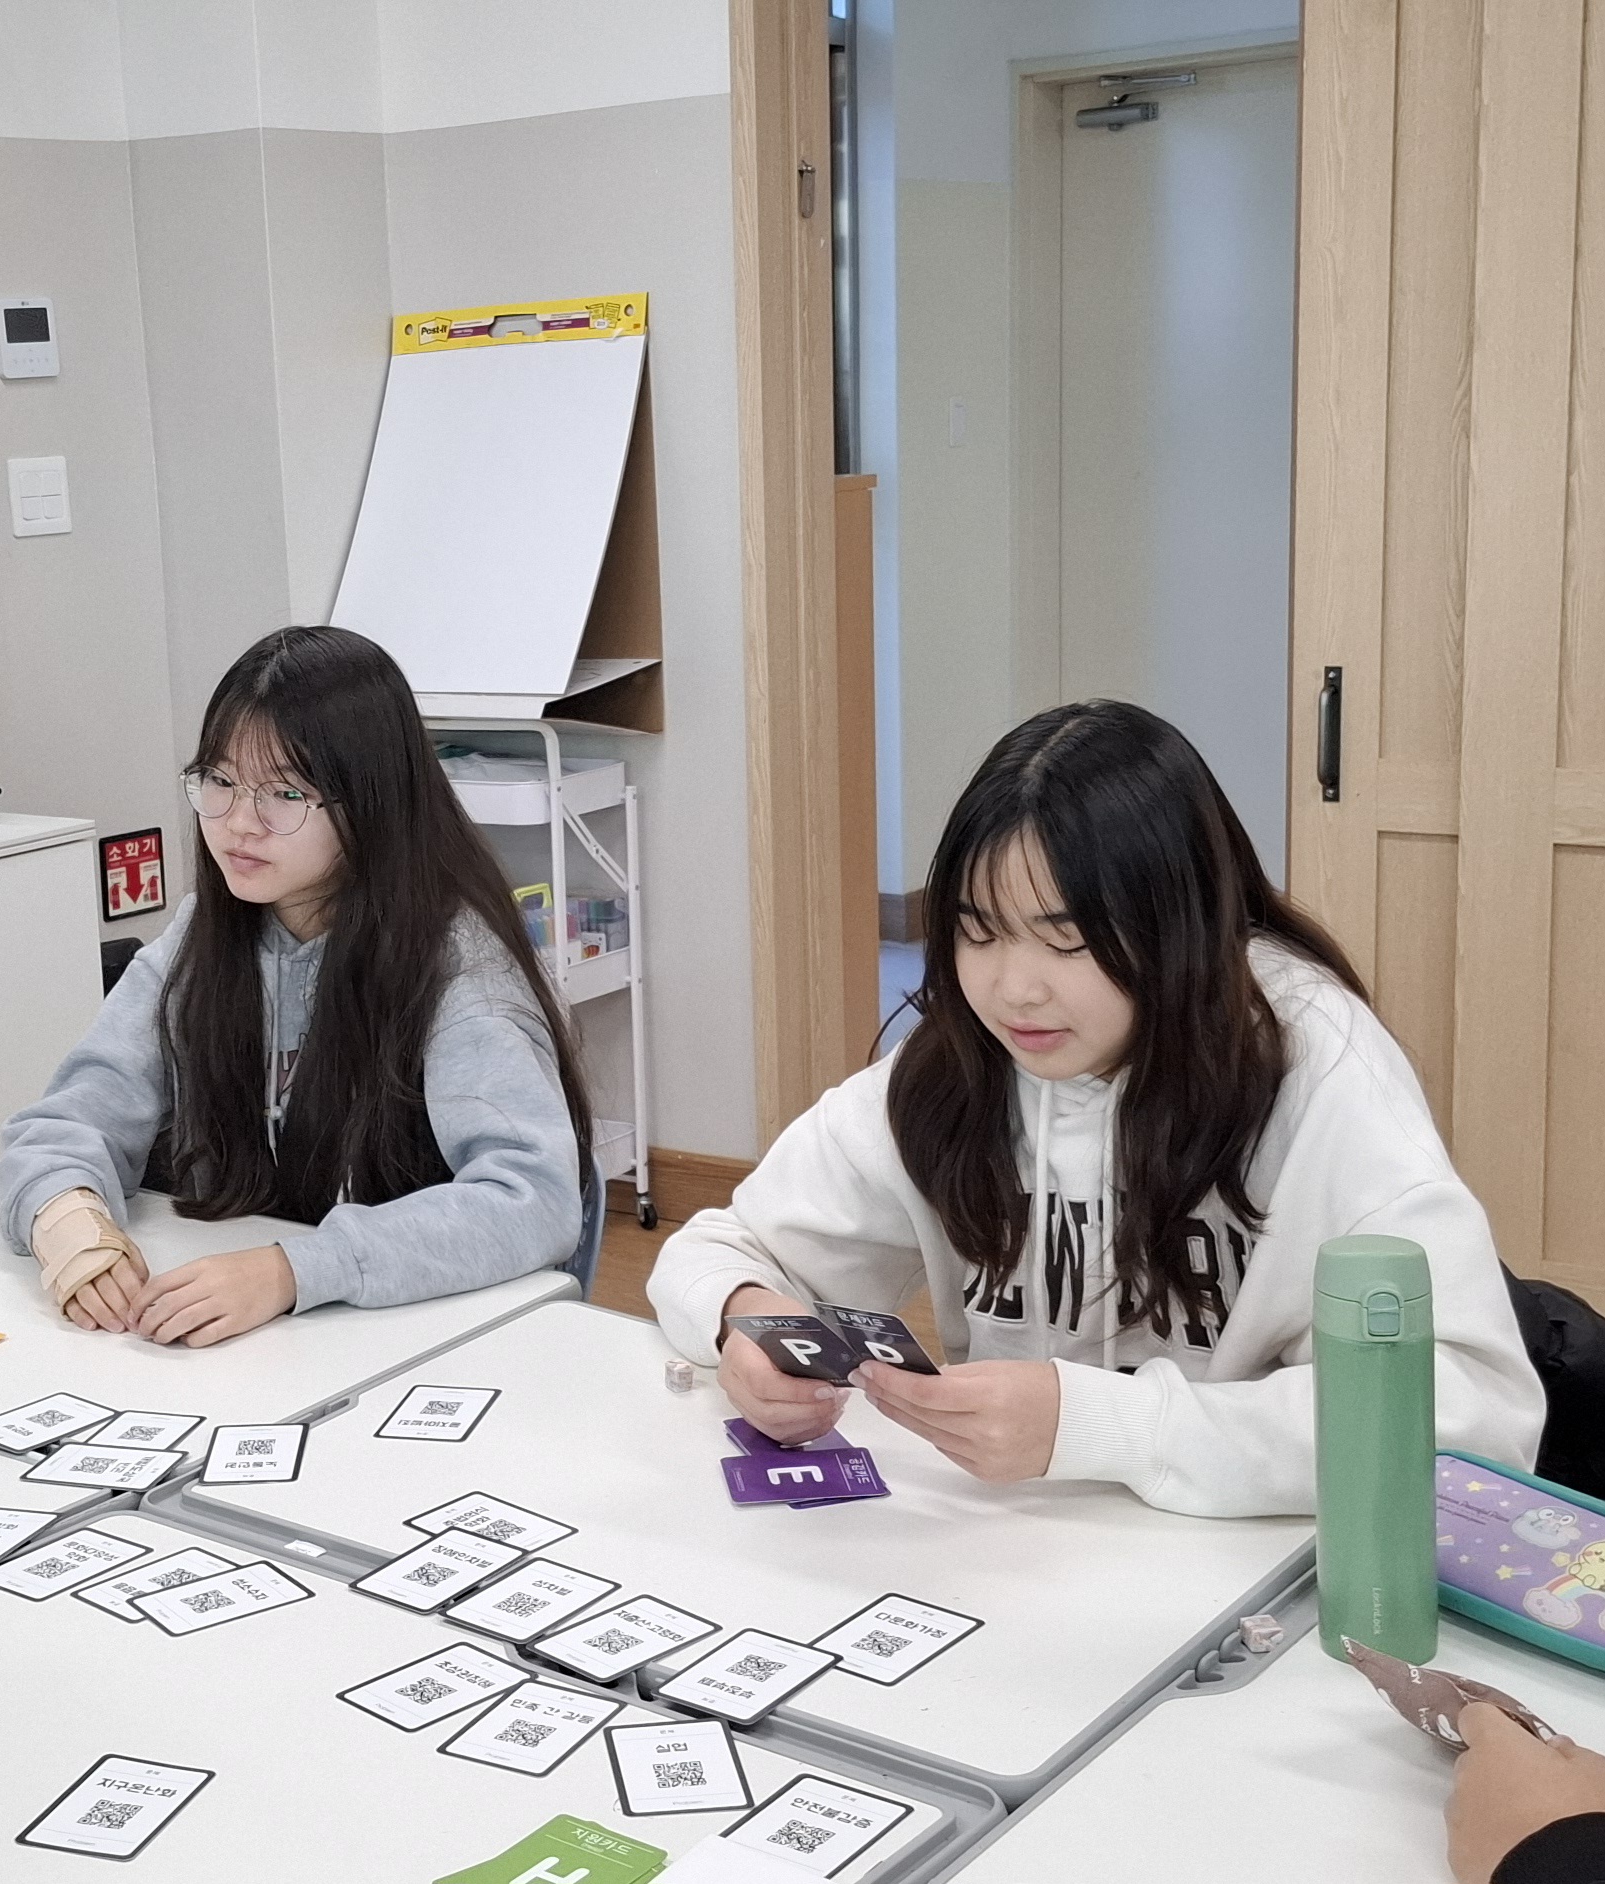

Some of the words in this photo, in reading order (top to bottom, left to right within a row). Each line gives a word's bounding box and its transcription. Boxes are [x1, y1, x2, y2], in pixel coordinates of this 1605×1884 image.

[108, 838, 156, 862] 소화기
[779, 1338, 822, 1366] P
[766, 1465, 825, 1486] E
[432, 1545, 493, 1568] 장애인차별
[232, 1579, 269, 1600] 성소수자
[532, 1580, 573, 1596] 성차별
[874, 1612, 948, 1638] 다문화가정
[434, 1661, 495, 1689] 초상권침해
[697, 1677, 755, 1699] 부정부패
[510, 1699, 541, 1711] 민족
[543, 1707, 560, 1716] 간
[561, 1711, 595, 1724] 갈등
[656, 1743, 688, 1753] 실업
[96, 1778, 177, 1798] 지구온난화
[790, 1798, 873, 1828] 안전불감증
[571, 1827, 632, 1856] 지원카드
